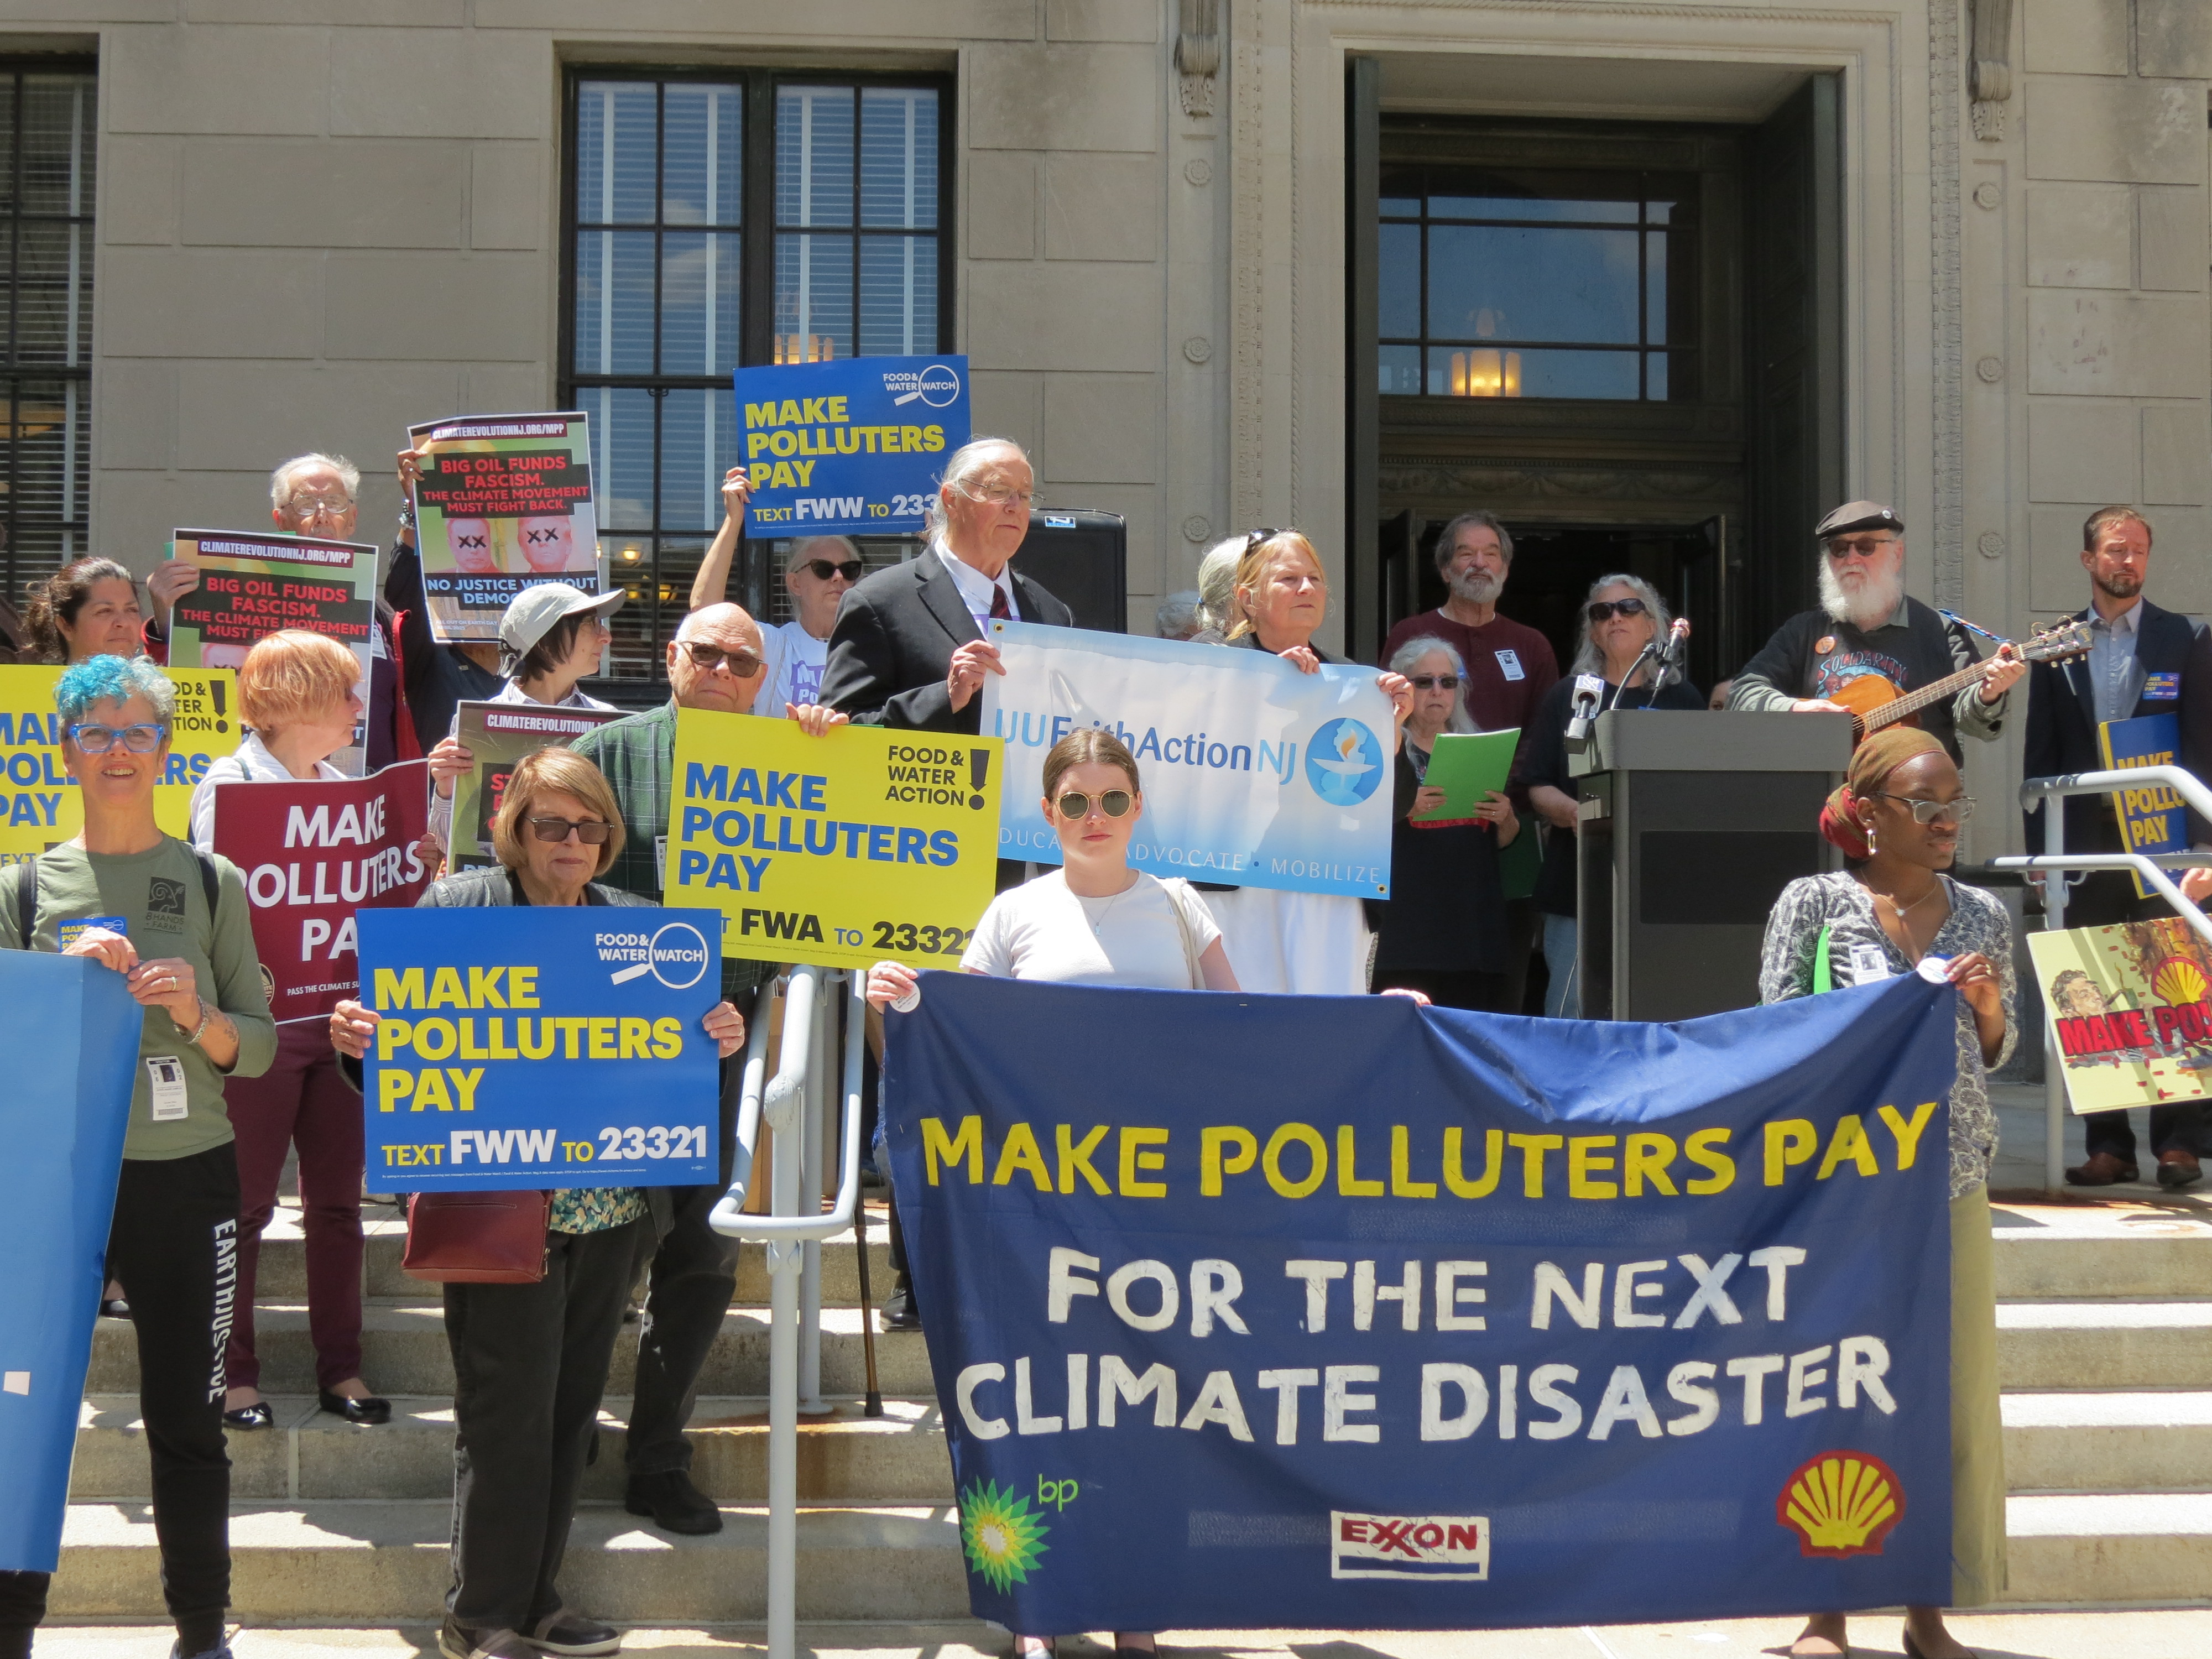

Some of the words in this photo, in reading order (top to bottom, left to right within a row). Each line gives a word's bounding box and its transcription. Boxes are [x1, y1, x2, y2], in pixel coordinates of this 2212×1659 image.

[885, 382, 917, 391] WATER
[921, 382, 956, 390] WATCH
[745, 396, 849, 429] MAKE
[432, 423, 564, 440] CLIMATEREVOLUTIONNJ.ORG/MPP
[747, 425, 946, 459] POLLUTERS
[441, 459, 471, 473] BIG
[475, 458, 504, 472] OIL
[508, 456, 566, 471] FUNDS
[749, 460, 816, 489] PAY
[423, 491, 449, 501] THE
[451, 489, 509, 500] CLIMATE
[512, 486, 588, 499] MOVEMENT
[465, 473, 544, 488] FASCISM.
[447, 502, 484, 513] MUST
[487, 501, 526, 512] FIGHT
[529, 499, 567, 510] BACK.
[753, 508, 792, 521] TEXT
[795, 497, 863, 520] FWW
[868, 504, 889, 518] TO
[201, 541, 351, 564] CLIMATEREVOLUTIONNJ.ORG/MPP
[207, 577, 240, 593] BIG
[246, 580, 277, 596] OIL
[283, 584, 348, 603] FUNDS
[427, 579, 451, 591] NO
[455, 578, 518, 591] JUSTICE
[232, 597, 321, 618] FASCISM.
[181, 609, 211, 622] THE
[215, 612, 280, 628] CLIMATE
[283, 619, 369, 635] MOVEMENT
[207, 625, 249, 638] MUST
[1818, 651, 1907, 684] SOLIDARITY
[195, 682, 207, 696] &
[174, 699, 204, 713] TER
[173, 717, 212, 731] TION
[888, 745, 948, 765] FOOD
[950, 750, 964, 766] &
[685, 761, 827, 812] MAKE
[888, 765, 956, 785] WATER
[885, 786, 964, 806] ACTION
[284, 794, 385, 848] MAKE
[2130, 815, 2169, 847] PAY
[681, 806, 959, 867] POLLUTERS
[678, 849, 773, 893] PAY
[1271, 859, 1380, 884] MOBILIZE
[301, 917, 358, 962] PA
[741, 907, 825, 943] FWA
[834, 928, 864, 947] TO
[598, 948, 647, 962] WATER
[653, 949, 703, 962] WATCH
[287, 987, 304, 996] PASS
[305, 984, 317, 994] THE
[319, 982, 351, 992] CLIMATE
[374, 966, 540, 1010] MAKE
[377, 1016, 682, 1061] POLLUTERS
[2055, 1008, 2156, 1057] MAKE
[379, 1068, 485, 1112] PAY
[381, 1144, 445, 1166] TEXT
[450, 1129, 557, 1164] FWW
[562, 1141, 594, 1162] TO
[598, 1125, 707, 1161] 23321
[920, 1115, 1170, 1198] MAKE
[1200, 1122, 1736, 1199] POLLUTERS
[1763, 1102, 1938, 1186] PAY
[1048, 1246, 1252, 1338] FOR
[1285, 1259, 1488, 1334] THE
[1530, 1245, 1807, 1330] NEXT
[956, 1353, 1380, 1445] CLIMATE
[1420, 1335, 1897, 1442] DISASTER
[1037, 1473, 1078, 1512] bp
[1340, 1519, 1478, 1558] EXXON
